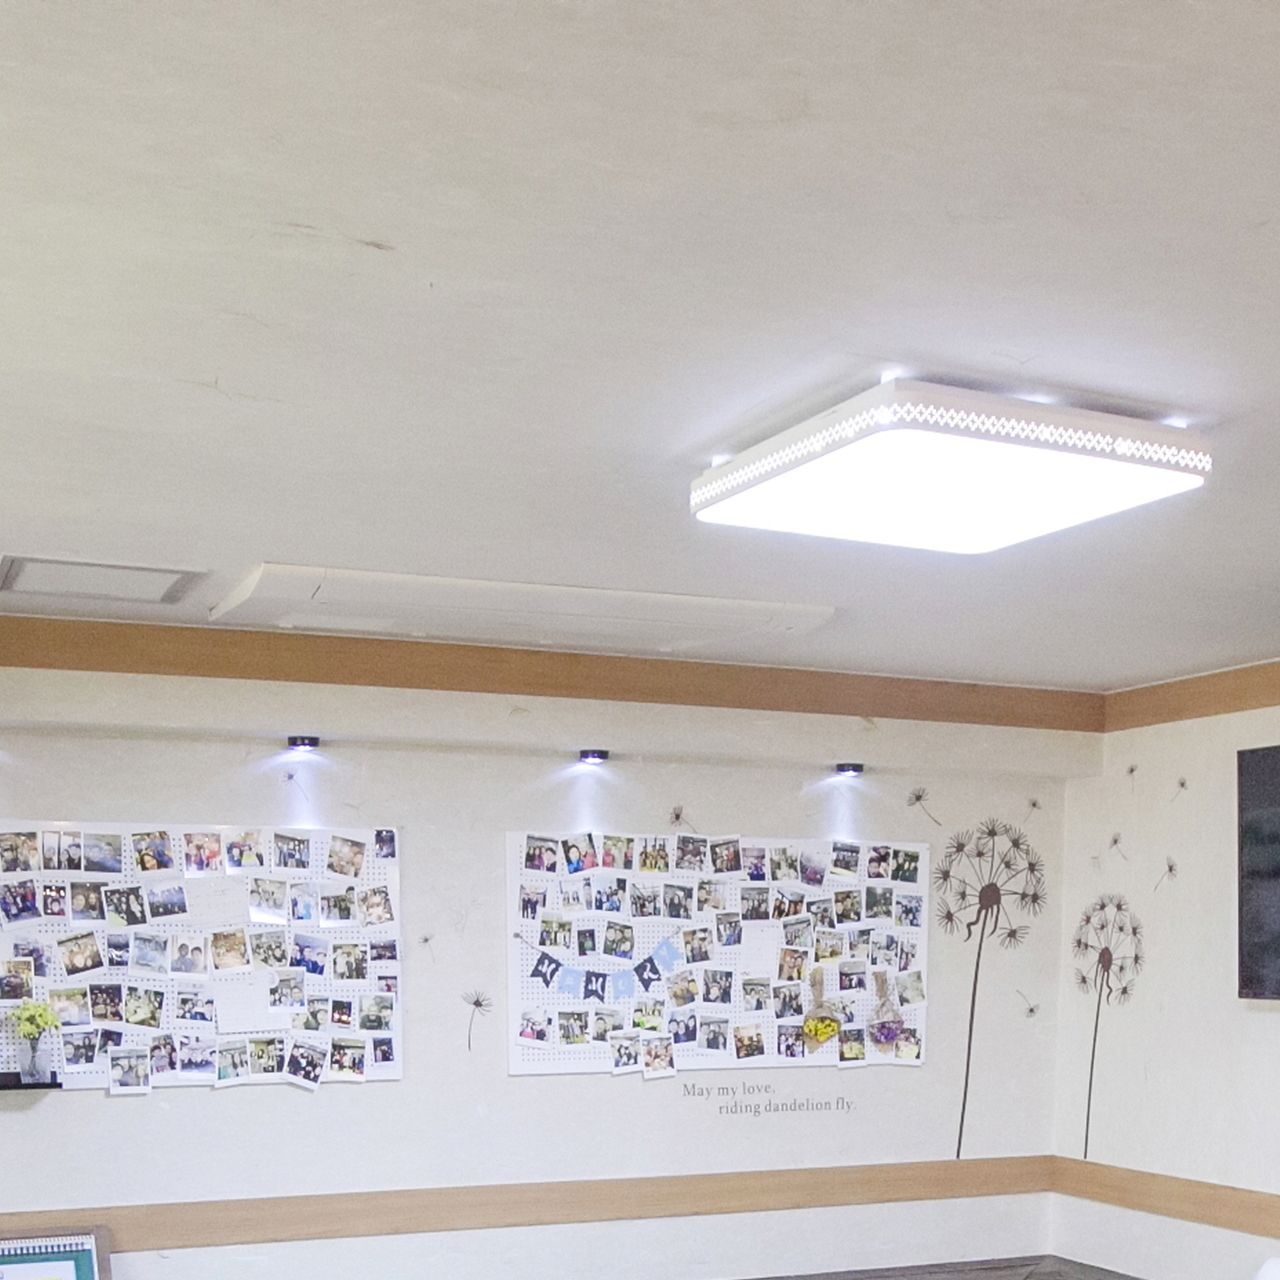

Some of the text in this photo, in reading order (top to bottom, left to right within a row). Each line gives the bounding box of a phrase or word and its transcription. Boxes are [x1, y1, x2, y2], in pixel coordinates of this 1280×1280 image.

[682, 1082, 713, 1100] May
[717, 1085, 738, 1100] my
[719, 1099, 761, 1117] riding
[764, 1097, 832, 1113] dandelion
